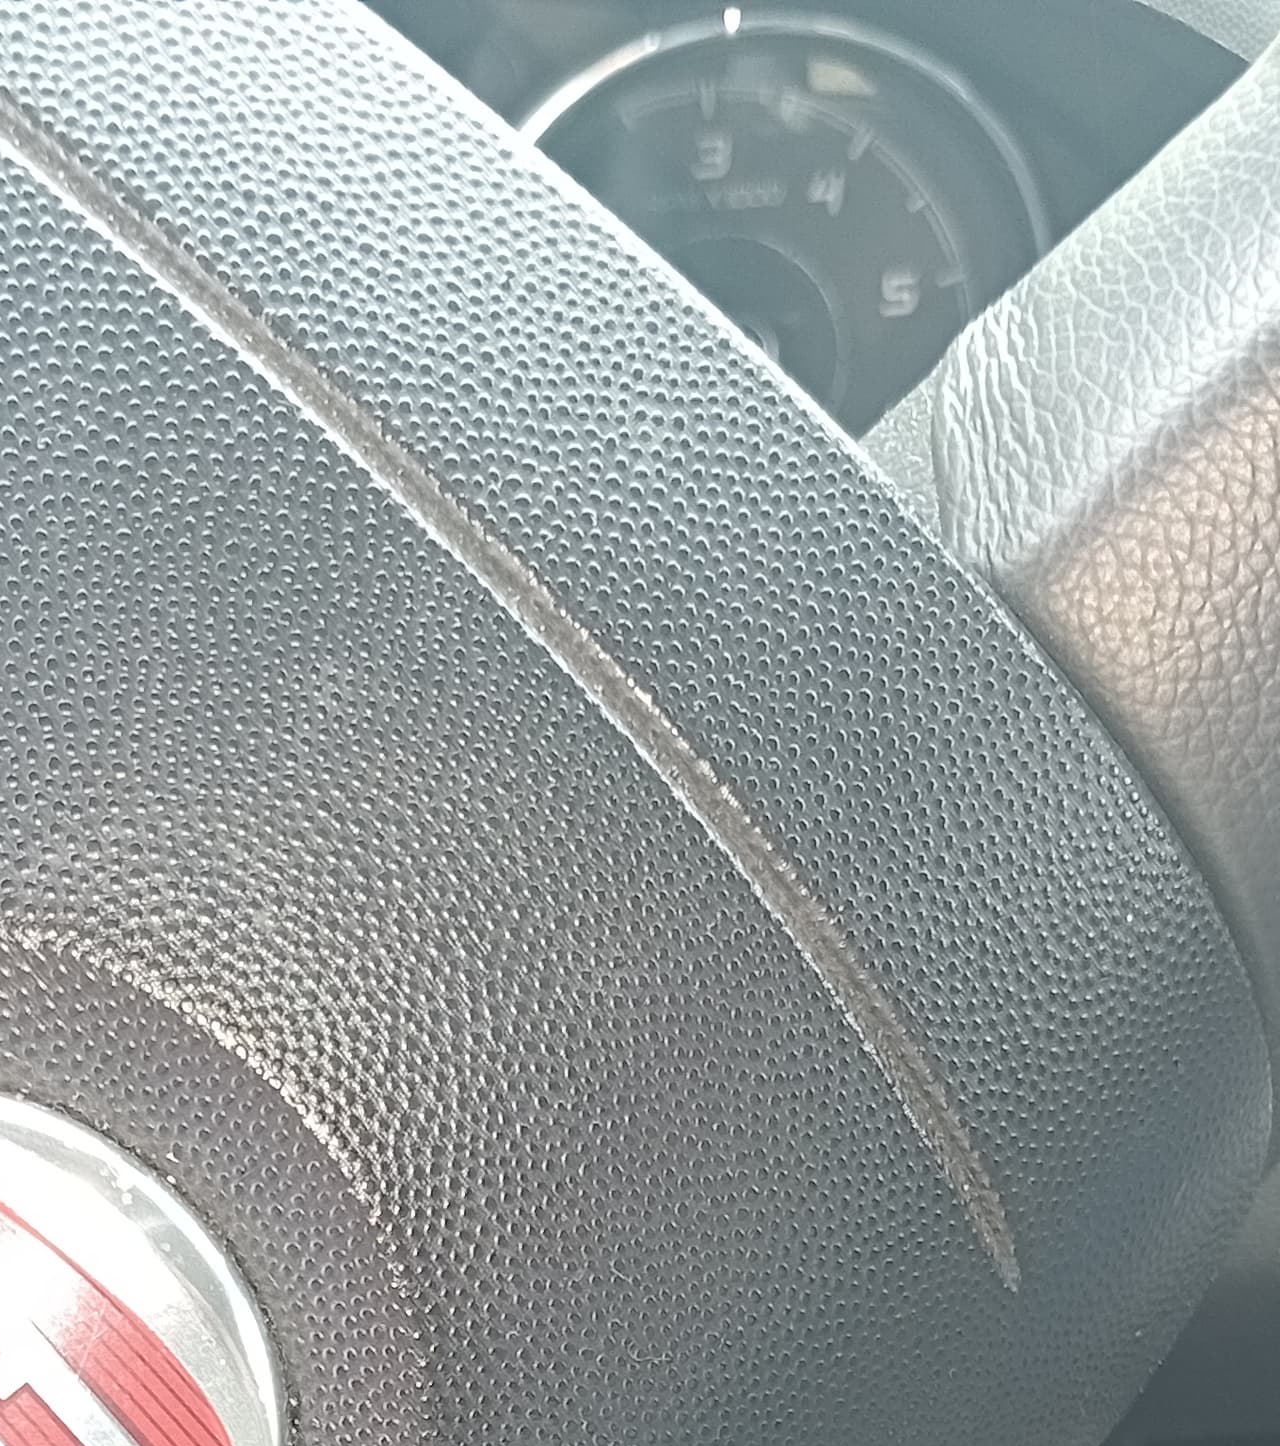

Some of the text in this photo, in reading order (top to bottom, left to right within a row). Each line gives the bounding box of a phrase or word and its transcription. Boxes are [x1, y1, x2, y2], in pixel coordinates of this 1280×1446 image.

[691, 131, 732, 180] 3
[807, 170, 846, 216] 4
[879, 269, 918, 316] 5
